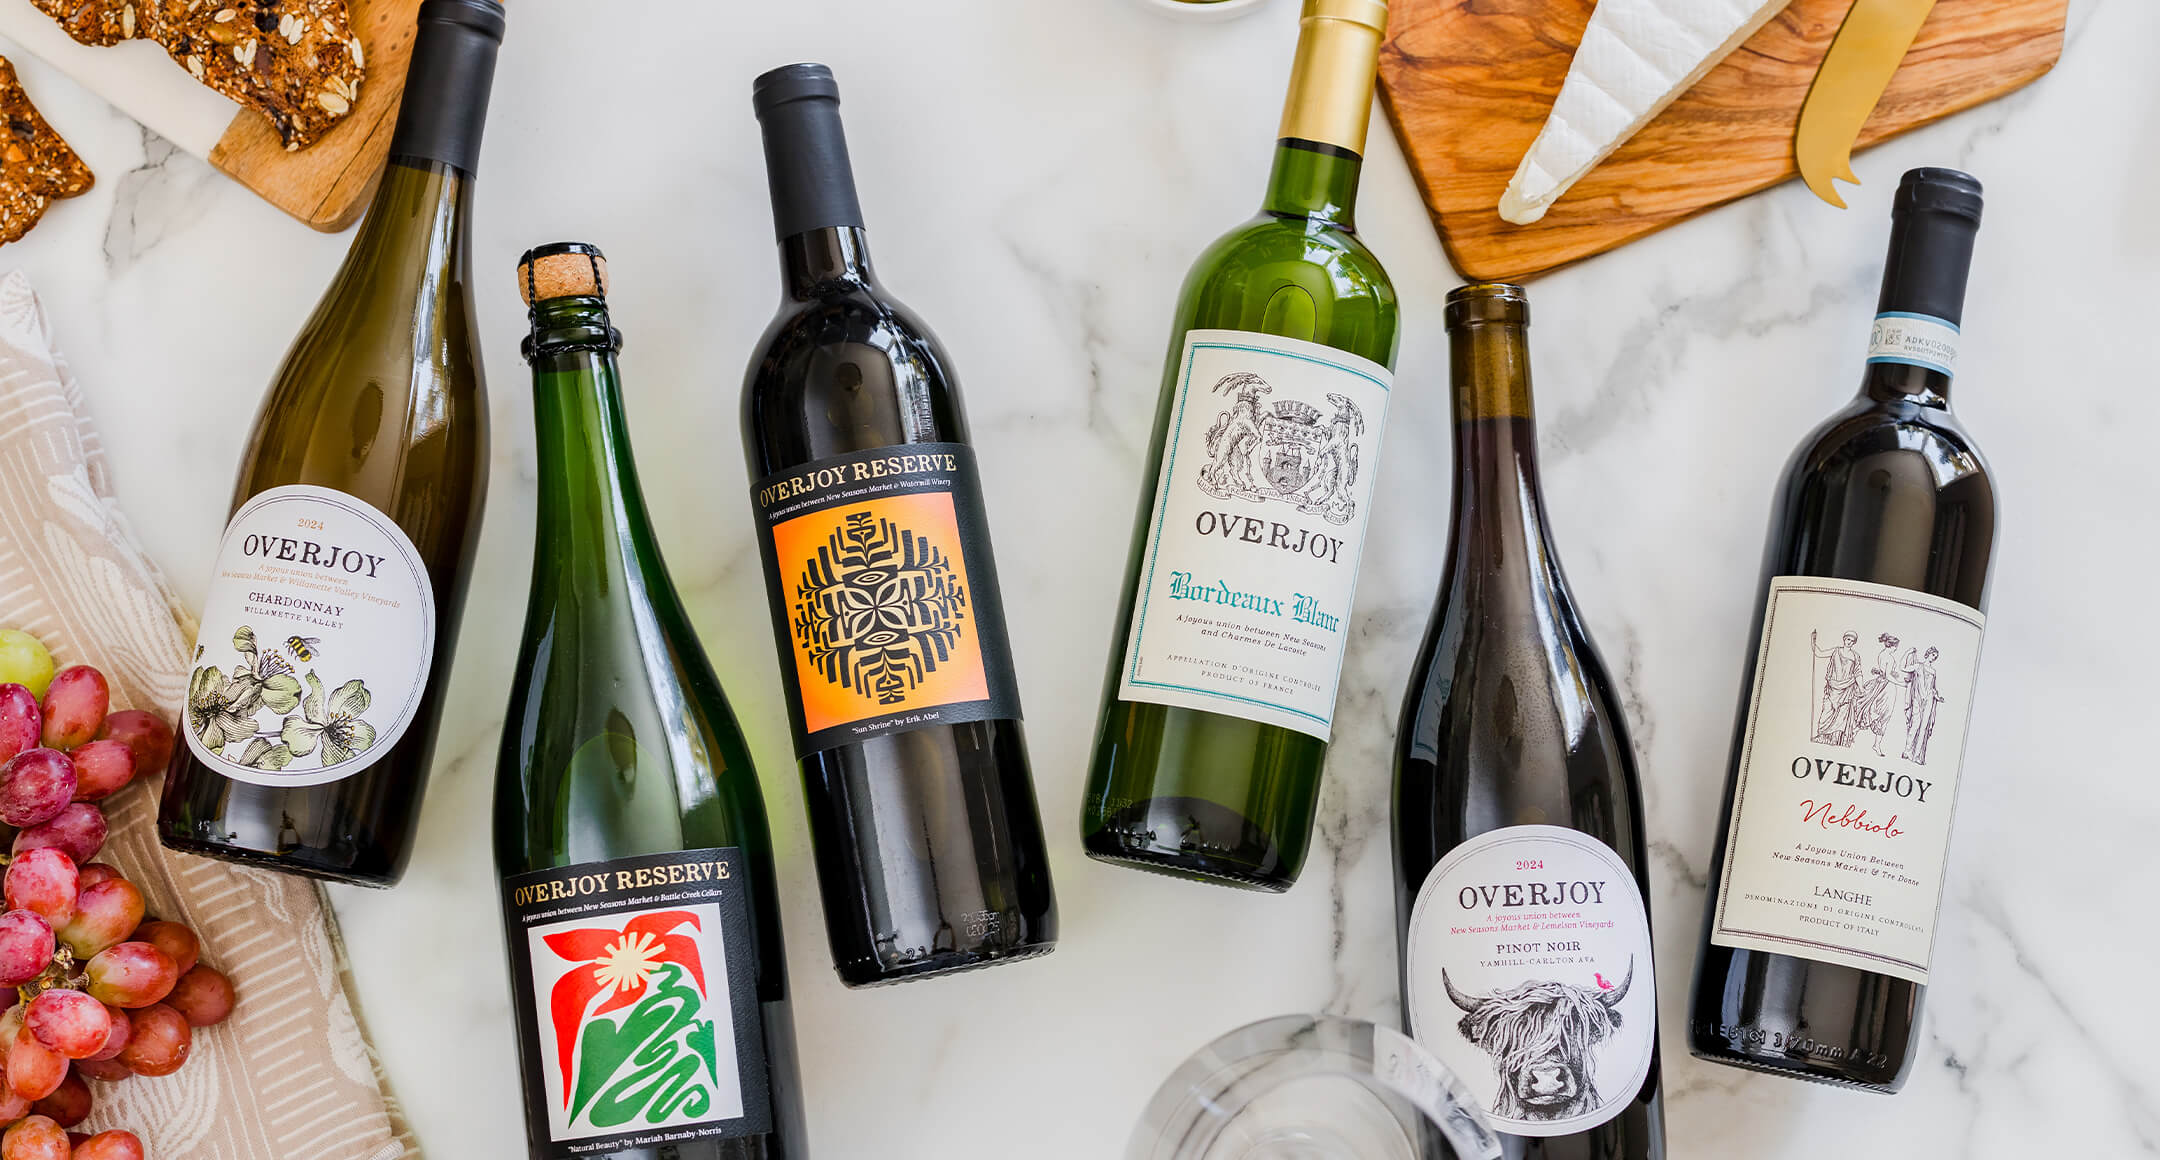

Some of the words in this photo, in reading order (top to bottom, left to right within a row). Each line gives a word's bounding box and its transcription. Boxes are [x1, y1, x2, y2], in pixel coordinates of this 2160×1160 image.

[760, 465, 846, 508] OVERJOY
[852, 454, 956, 480] RESERVE
[801, 497, 825, 508] between
[842, 488, 867, 498] Seasons
[868, 484, 892, 494] Market
[900, 479, 930, 488] Watermill
[931, 478, 951, 487] Winery
[297, 518, 324, 530] 2024
[1196, 511, 1344, 564] OVERJOY
[244, 534, 385, 578] OVERJOY
[290, 568, 312, 578] union
[314, 571, 348, 584] between
[253, 572, 278, 582] Market
[288, 578, 332, 593] Willamette
[334, 585, 358, 600] Valley
[361, 591, 400, 608] Vineyards
[1168, 570, 1284, 617] Bordeaux
[1290, 592, 1340, 633] Blanc
[249, 592, 344, 616] CHARDONNAY
[244, 606, 302, 621] WILLAMETTE
[306, 615, 344, 630] VALLEY
[1176, 614, 1183, 622] A
[1216, 620, 1241, 630] union
[1244, 625, 1280, 638] between
[1283, 634, 1300, 644] New
[1302, 638, 1326, 652] Seasons
[1201, 628, 1218, 636] and
[1221, 632, 1261, 646] Charmes
[1264, 640, 1276, 648] De
[1278, 643, 1308, 656] Lacoste
[1167, 654, 1228, 669] APPELLATION
[1201, 670, 1243, 684] PRODUCT
[1262, 682, 1295, 696] FRANCE
[894, 718, 904, 727] by
[906, 715, 920, 724] Erik
[922, 712, 940, 721] Abel
[1792, 756, 1932, 803] OVERJOY
[1800, 800, 1904, 839] Nebbiolo
[1516, 860, 1544, 870] 2024
[1772, 852, 1790, 860] New
[1794, 855, 1831, 867] Seasons
[1834, 862, 1867, 874] Market
[1871, 868, 1880, 876] &
[1882, 870, 1896, 880] Tre
[1898, 874, 1920, 887] Donne
[1805, 844, 1836, 856] Joyous
[1840, 850, 1866, 862] Union
[1870, 856, 1904, 870] Between
[515, 872, 610, 906] OVERJOY
[616, 862, 730, 890] RESERVE
[1459, 881, 1606, 910] OVERJOY
[1814, 886, 1872, 906] LANGHE
[558, 906, 582, 915] between
[584, 903, 599, 912] New
[600, 900, 626, 910] Seasons
[628, 896, 654, 906] Market
[660, 892, 680, 901] Battle
[682, 890, 700, 899] Creek
[701, 888, 722, 898] Cellars
[1744, 893, 1818, 910] DENOMINAZIONE
[1837, 908, 1874, 920] ORIGINE
[1450, 927, 1466, 935] New
[1468, 926, 1498, 934] Seasons
[1501, 923, 1530, 932] Market
[1541, 922, 1577, 930] Lemelson
[1580, 920, 1614, 930] Vineyards
[1486, 914, 1492, 922] A
[1494, 914, 1520, 924] joyous
[1524, 912, 1547, 920] union
[1549, 911, 1582, 920] between
[1800, 914, 1840, 928] PRODUCT
[1856, 925, 1880, 936] ITALY
[1496, 943, 1540, 954] PINOT
[1547, 941, 1581, 952] NOIR
[1480, 957, 1574, 968] YAMHILL-CARLTON
[624, 1138, 634, 1147] by
[635, 1134, 663, 1145] Mariah
[664, 1126, 722, 1141] Barnaby-Norris
